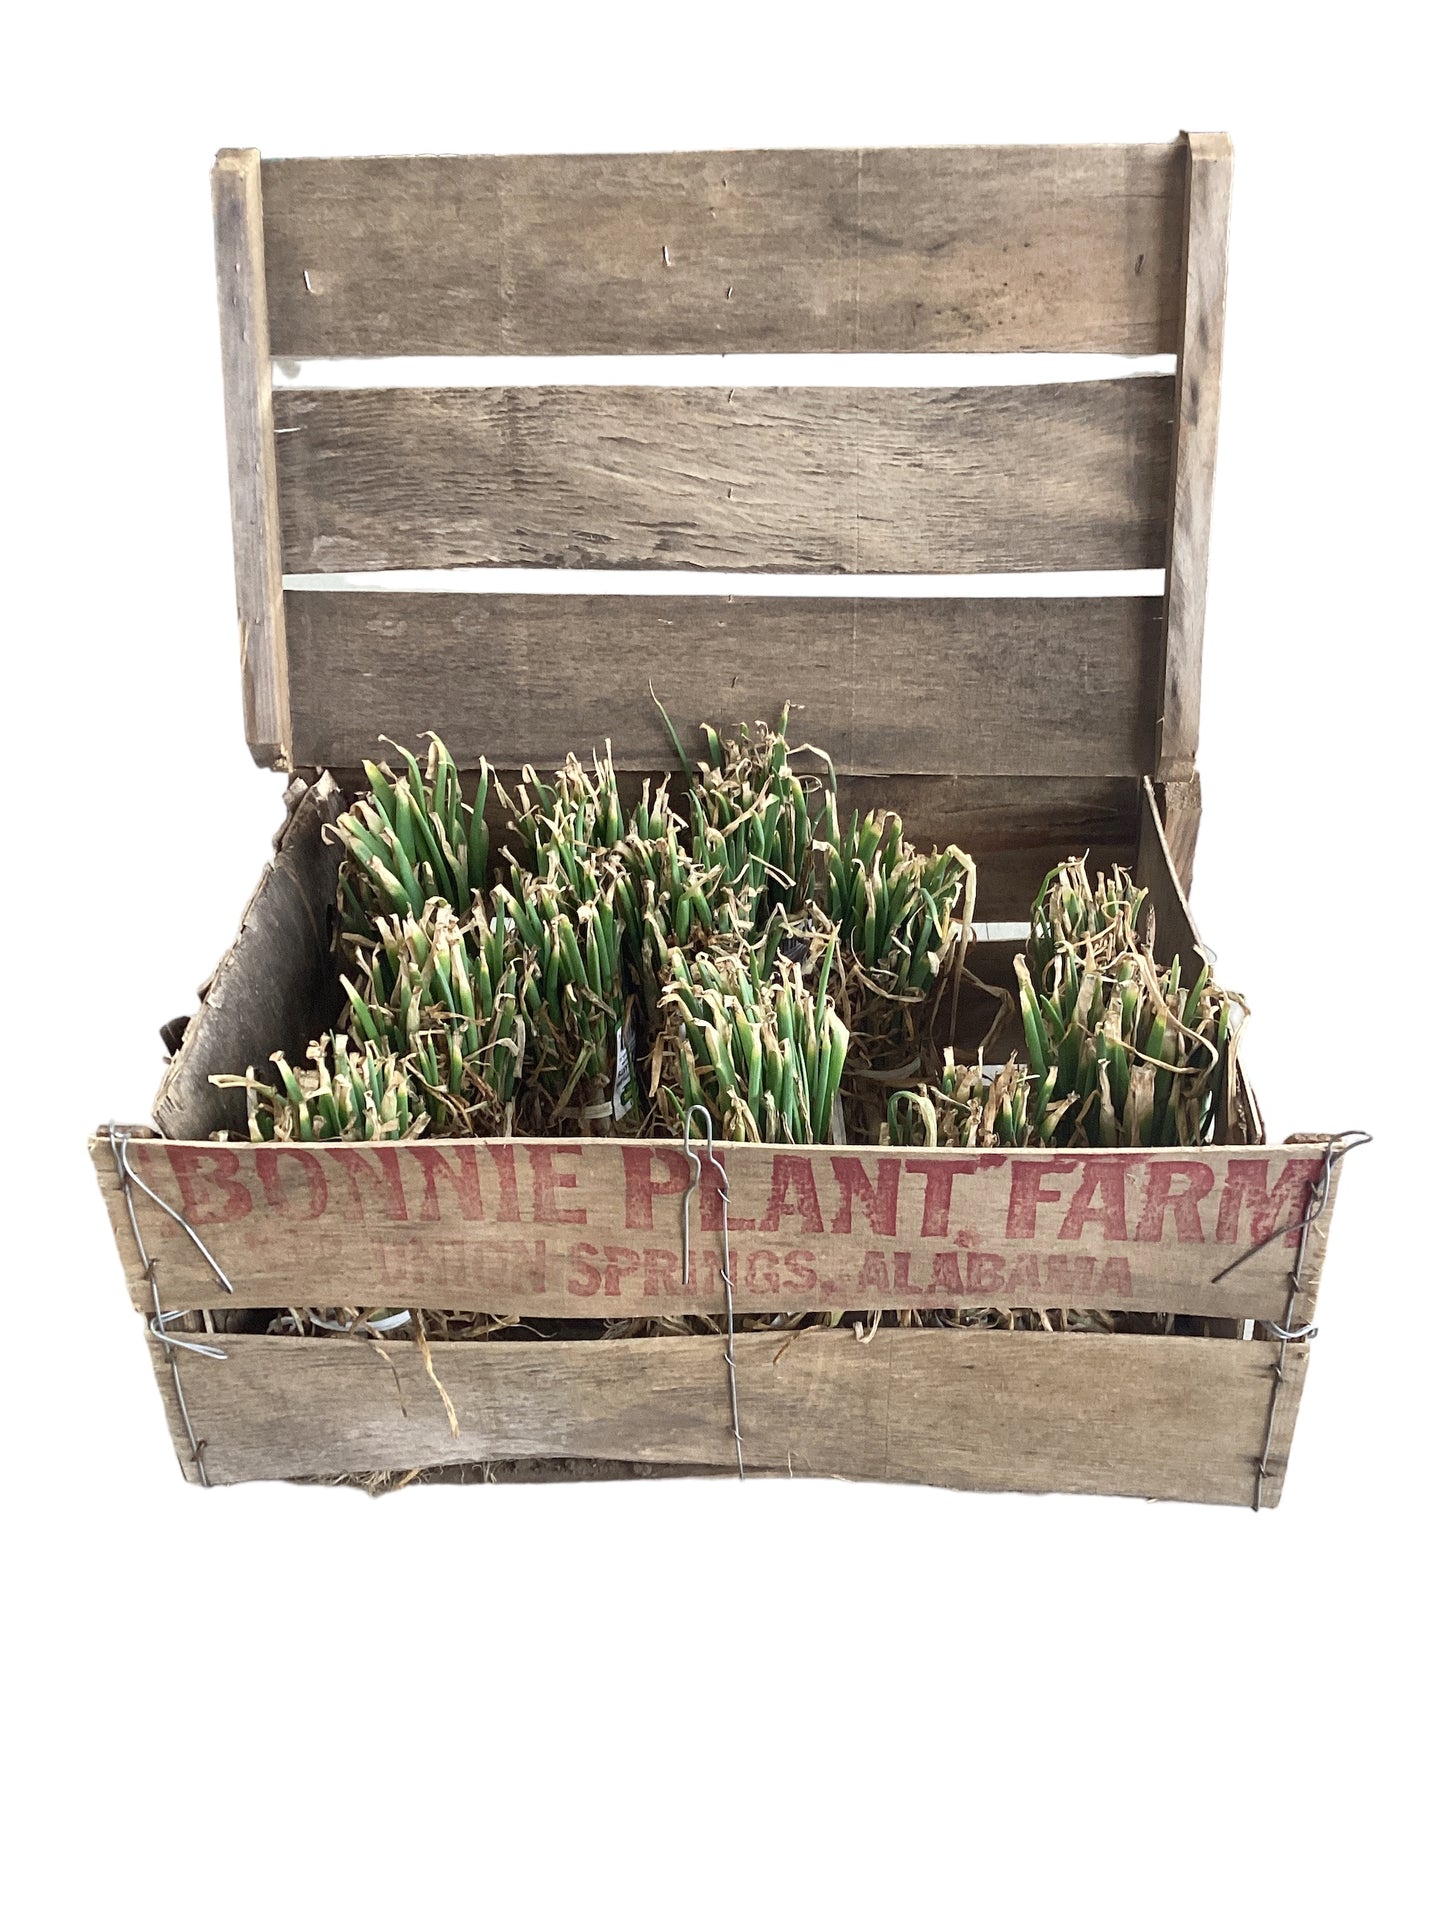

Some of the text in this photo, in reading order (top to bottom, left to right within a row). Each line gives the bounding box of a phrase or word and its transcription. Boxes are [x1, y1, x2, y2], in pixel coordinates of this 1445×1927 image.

[164, 1144, 1324, 1249] BONNIE PLANT FARM
[858, 1251, 1132, 1297] ALABAMA
